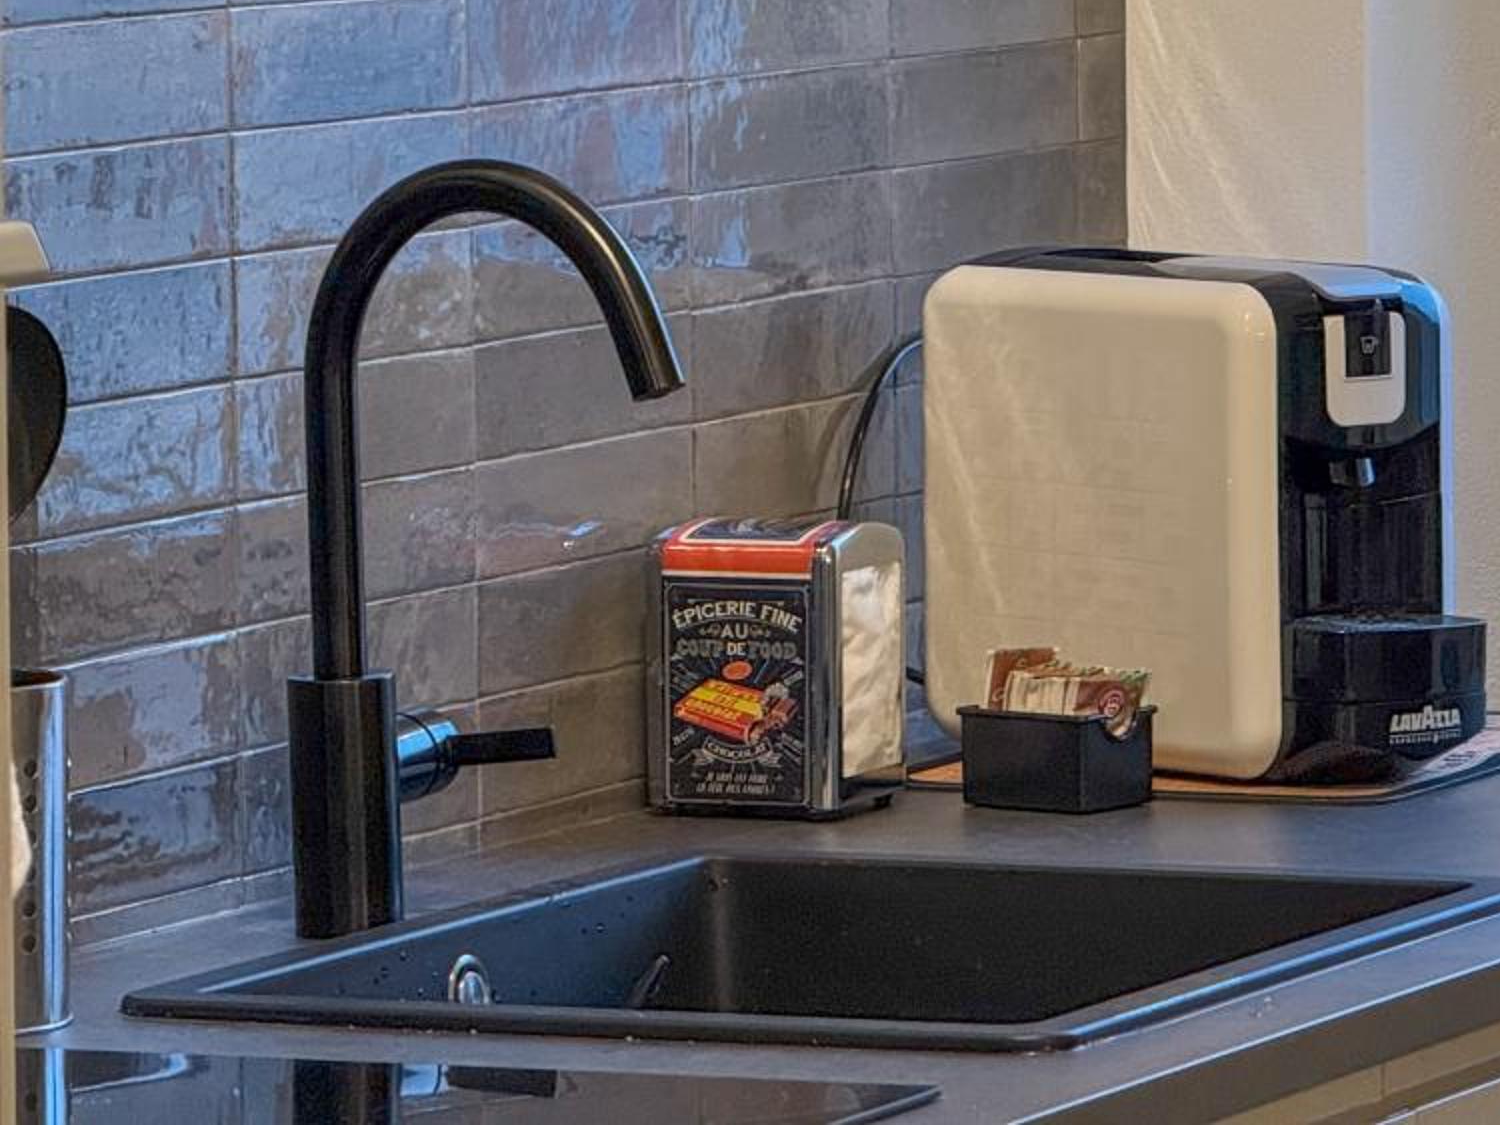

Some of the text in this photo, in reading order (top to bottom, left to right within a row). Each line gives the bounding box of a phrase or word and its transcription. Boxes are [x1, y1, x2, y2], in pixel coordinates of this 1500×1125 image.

[672, 600, 803, 633] ÉPICERIE FINE
[720, 622, 749, 639] AU
[676, 638, 797, 659] COUP DE FOOD
